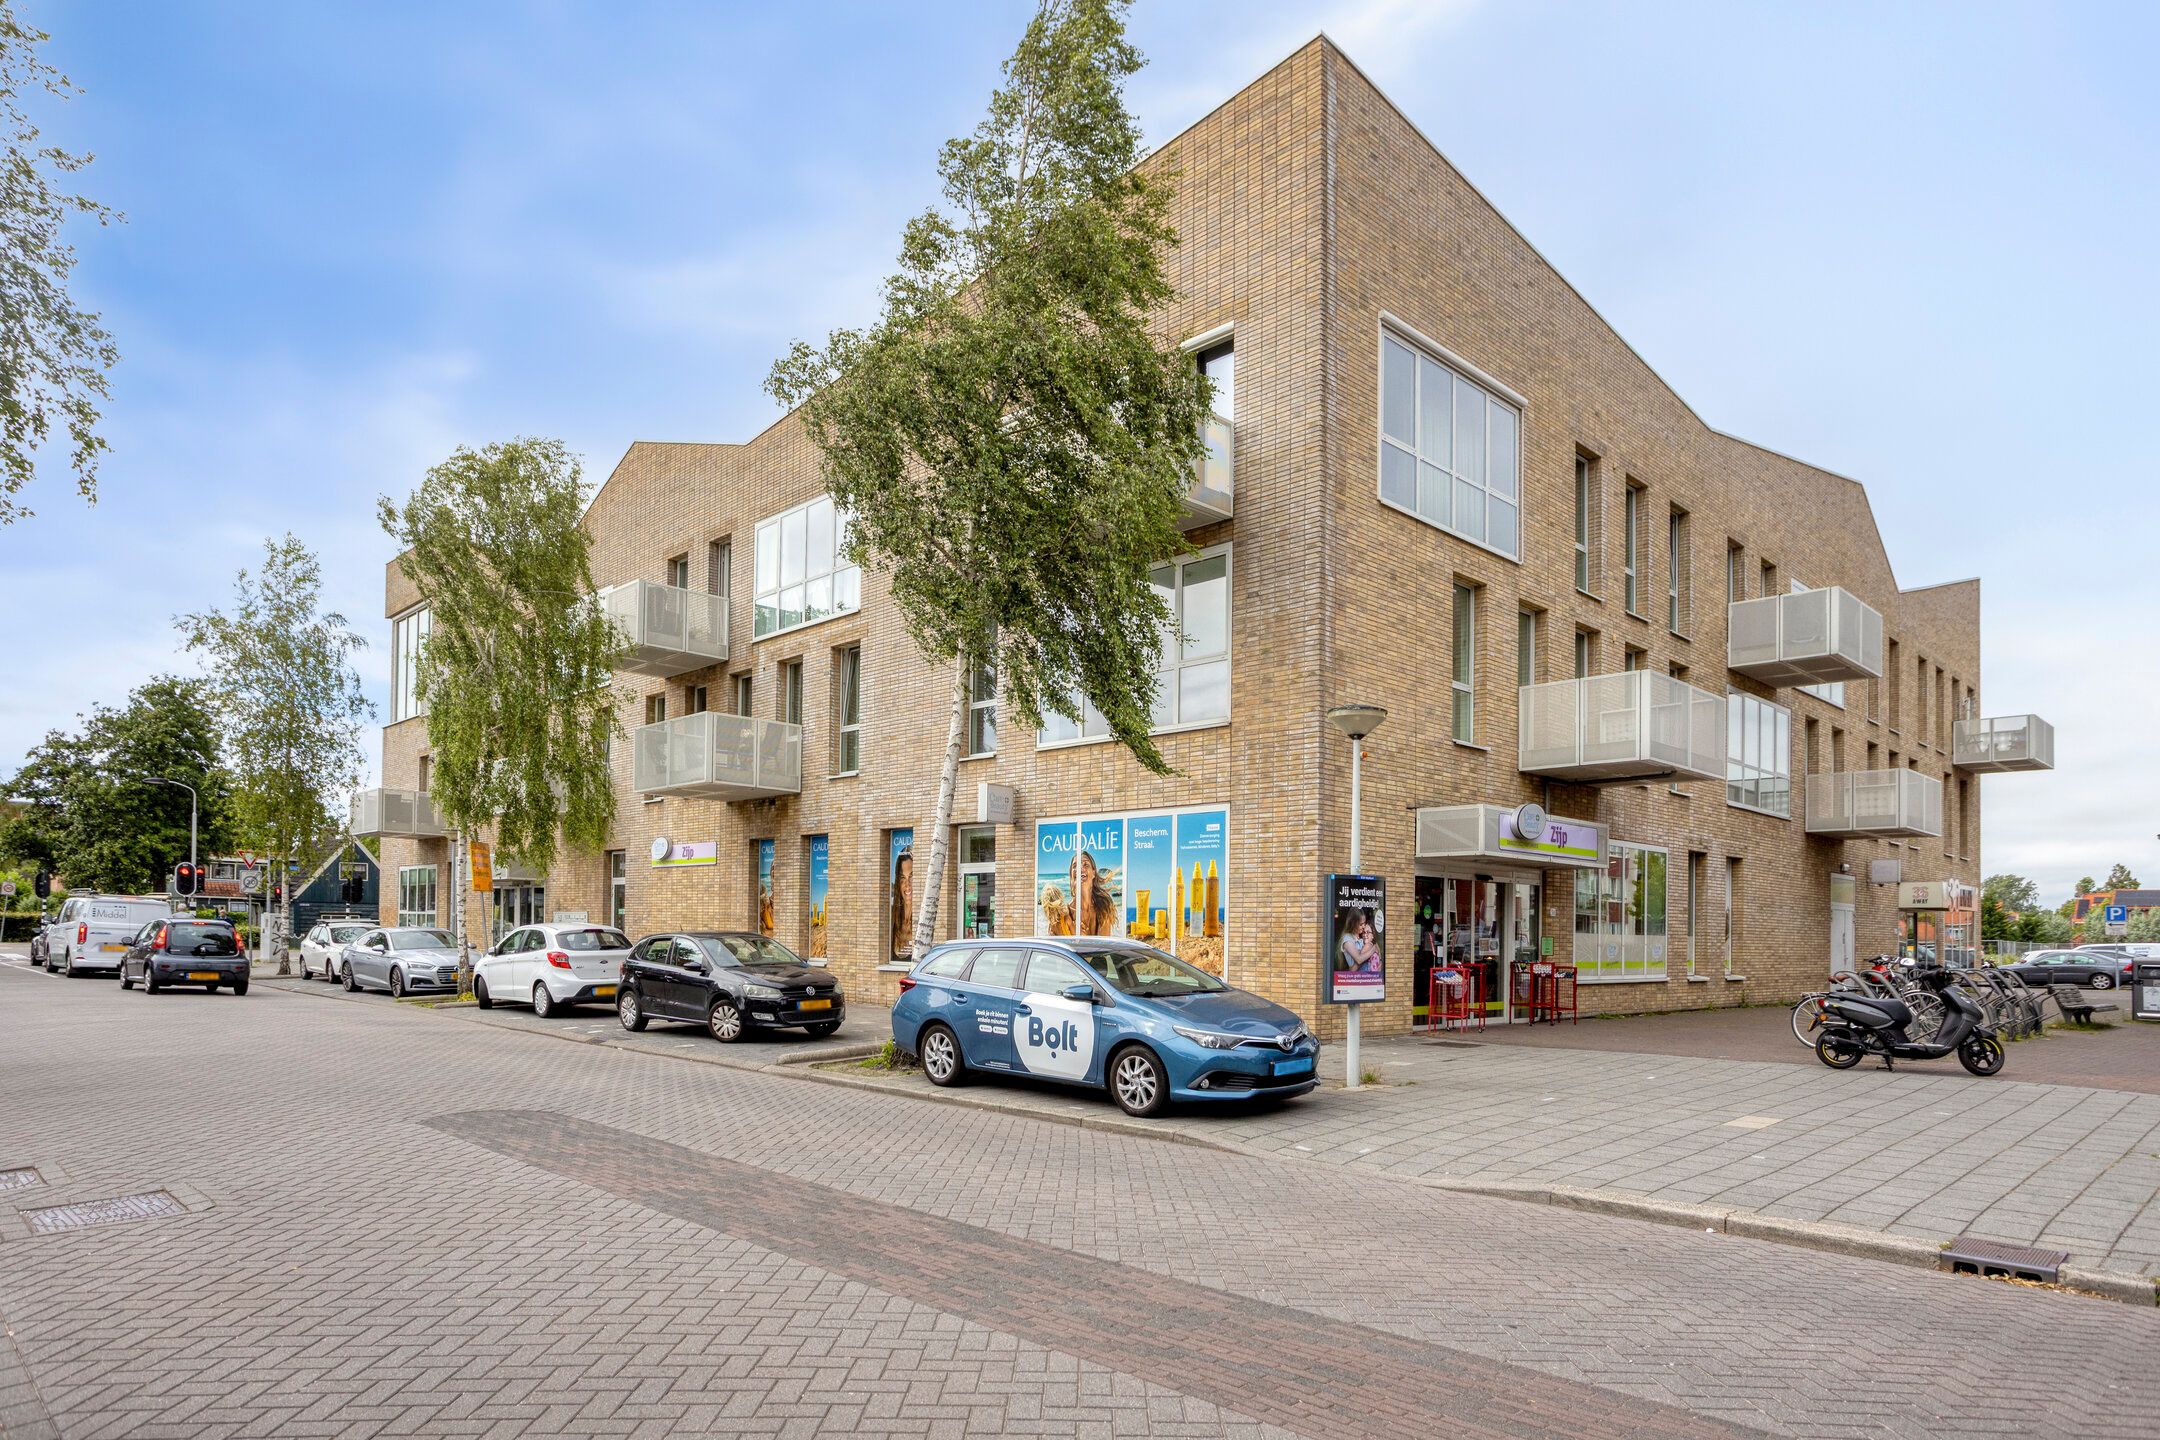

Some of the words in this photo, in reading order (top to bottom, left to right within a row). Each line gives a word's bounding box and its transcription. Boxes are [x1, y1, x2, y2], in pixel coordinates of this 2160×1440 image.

[1134, 828, 1169, 838] Bescherm.
[1551, 825, 1568, 849] Zijp
[1134, 840, 1155, 849] Straal.
[681, 846, 695, 860] Zijp
[1339, 886, 1350, 897] Jij
[1350, 887, 1376, 897] verdient
[2110, 907, 2122, 920] P
[1028, 1016, 1078, 1059] Bolt
